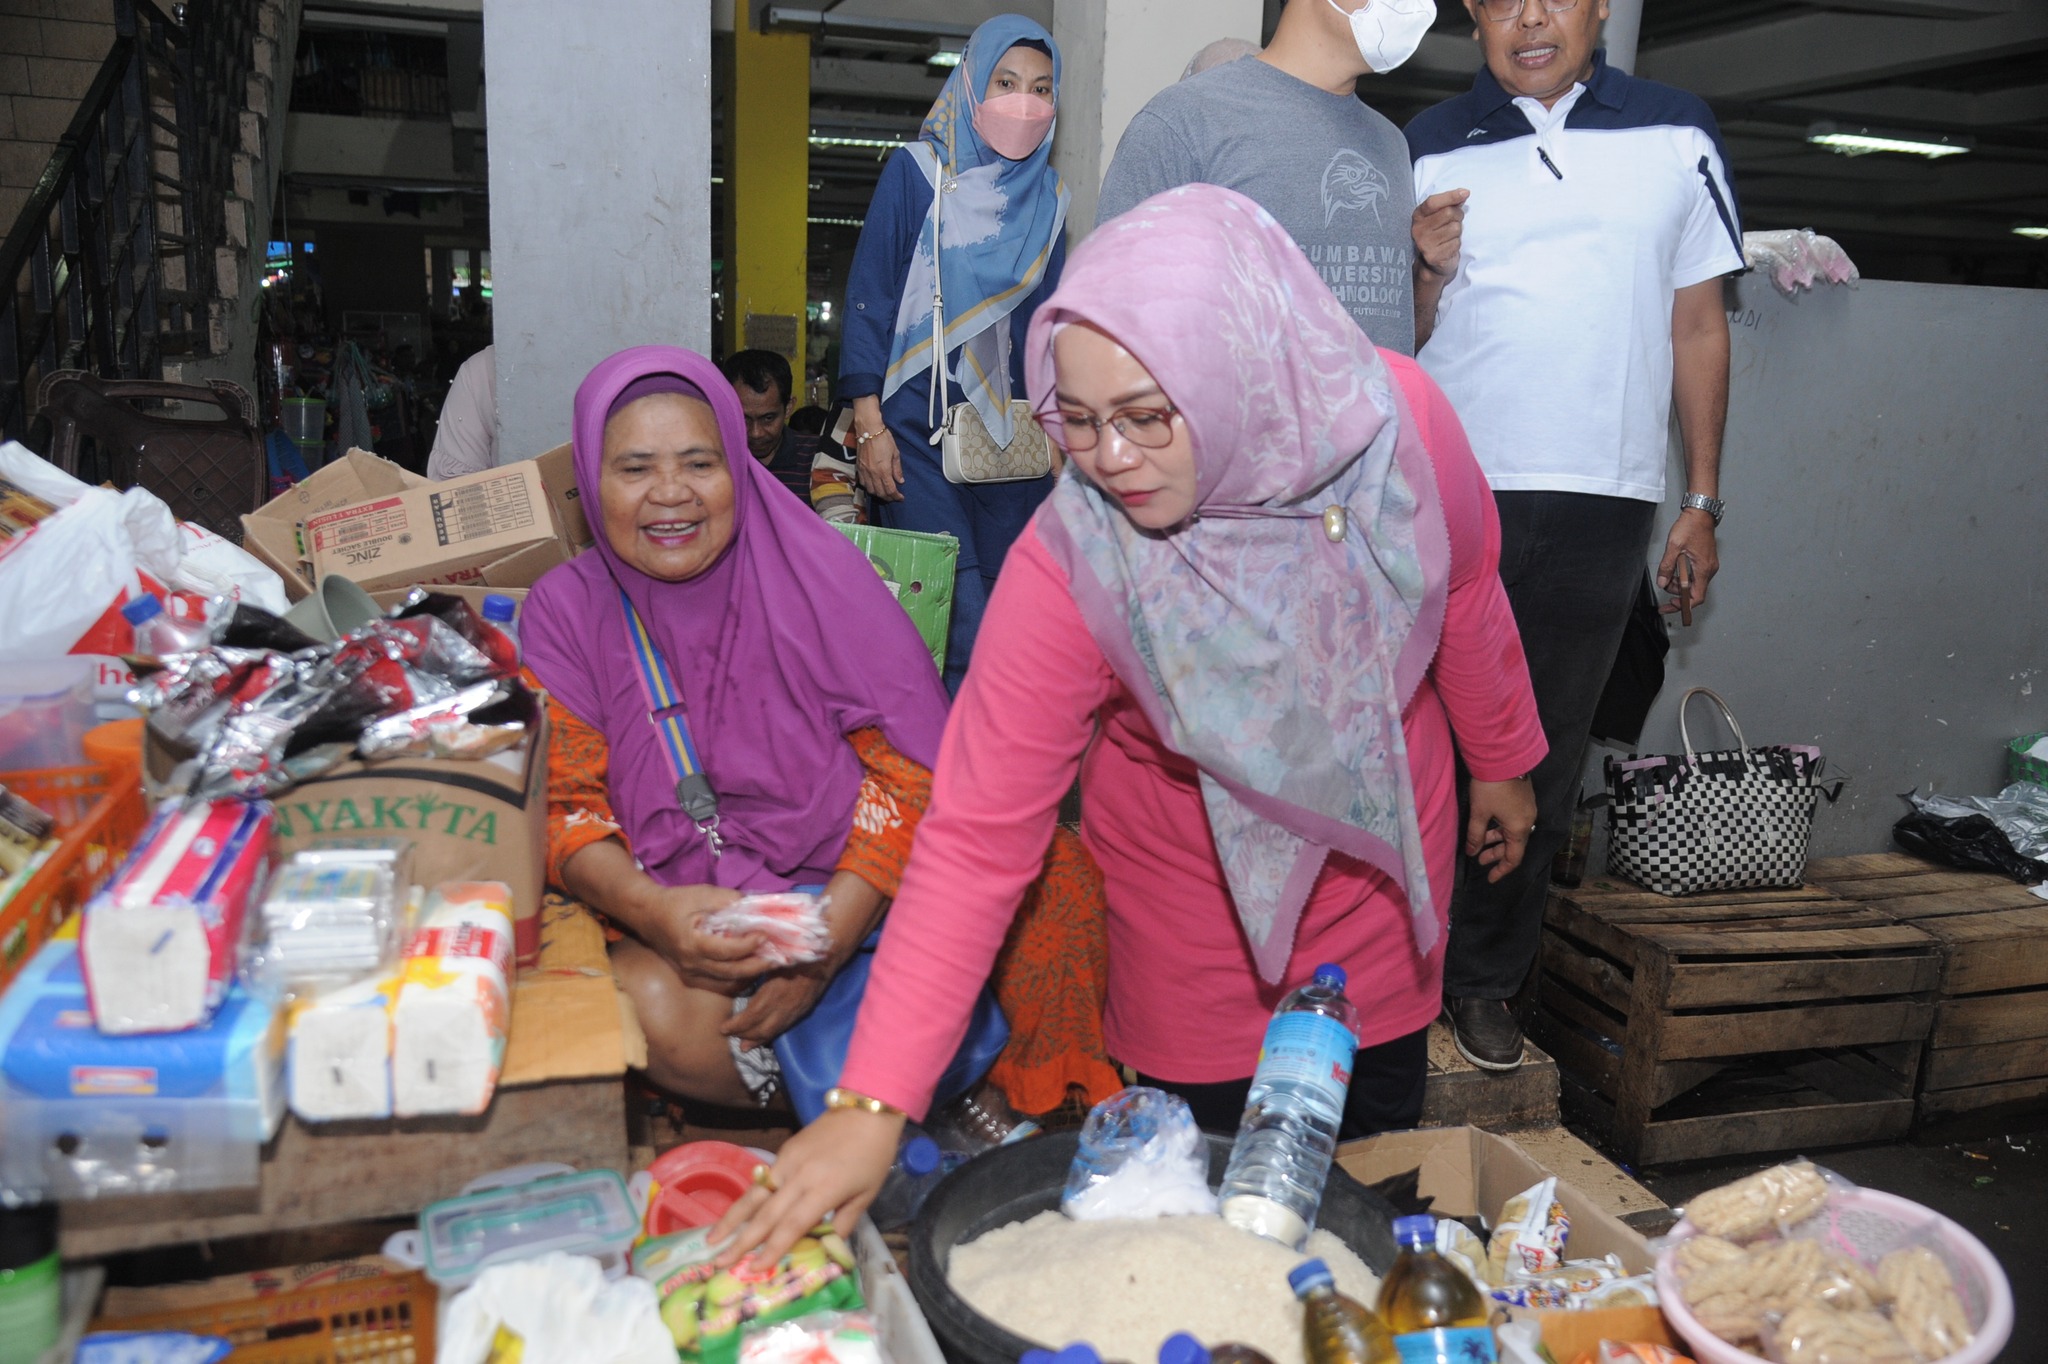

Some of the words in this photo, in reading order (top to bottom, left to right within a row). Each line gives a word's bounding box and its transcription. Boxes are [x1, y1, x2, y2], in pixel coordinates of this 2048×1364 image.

[1316, 265, 1406, 285] IVERSITY
[350, 504, 374, 516] EXTRA
[433, 498, 446, 541] REGULAR
[332, 540, 365, 555] SACHET
[367, 534, 393, 546] DOUBLE
[347, 547, 381, 566] ZINC
[444, 566, 486, 582] TRA
